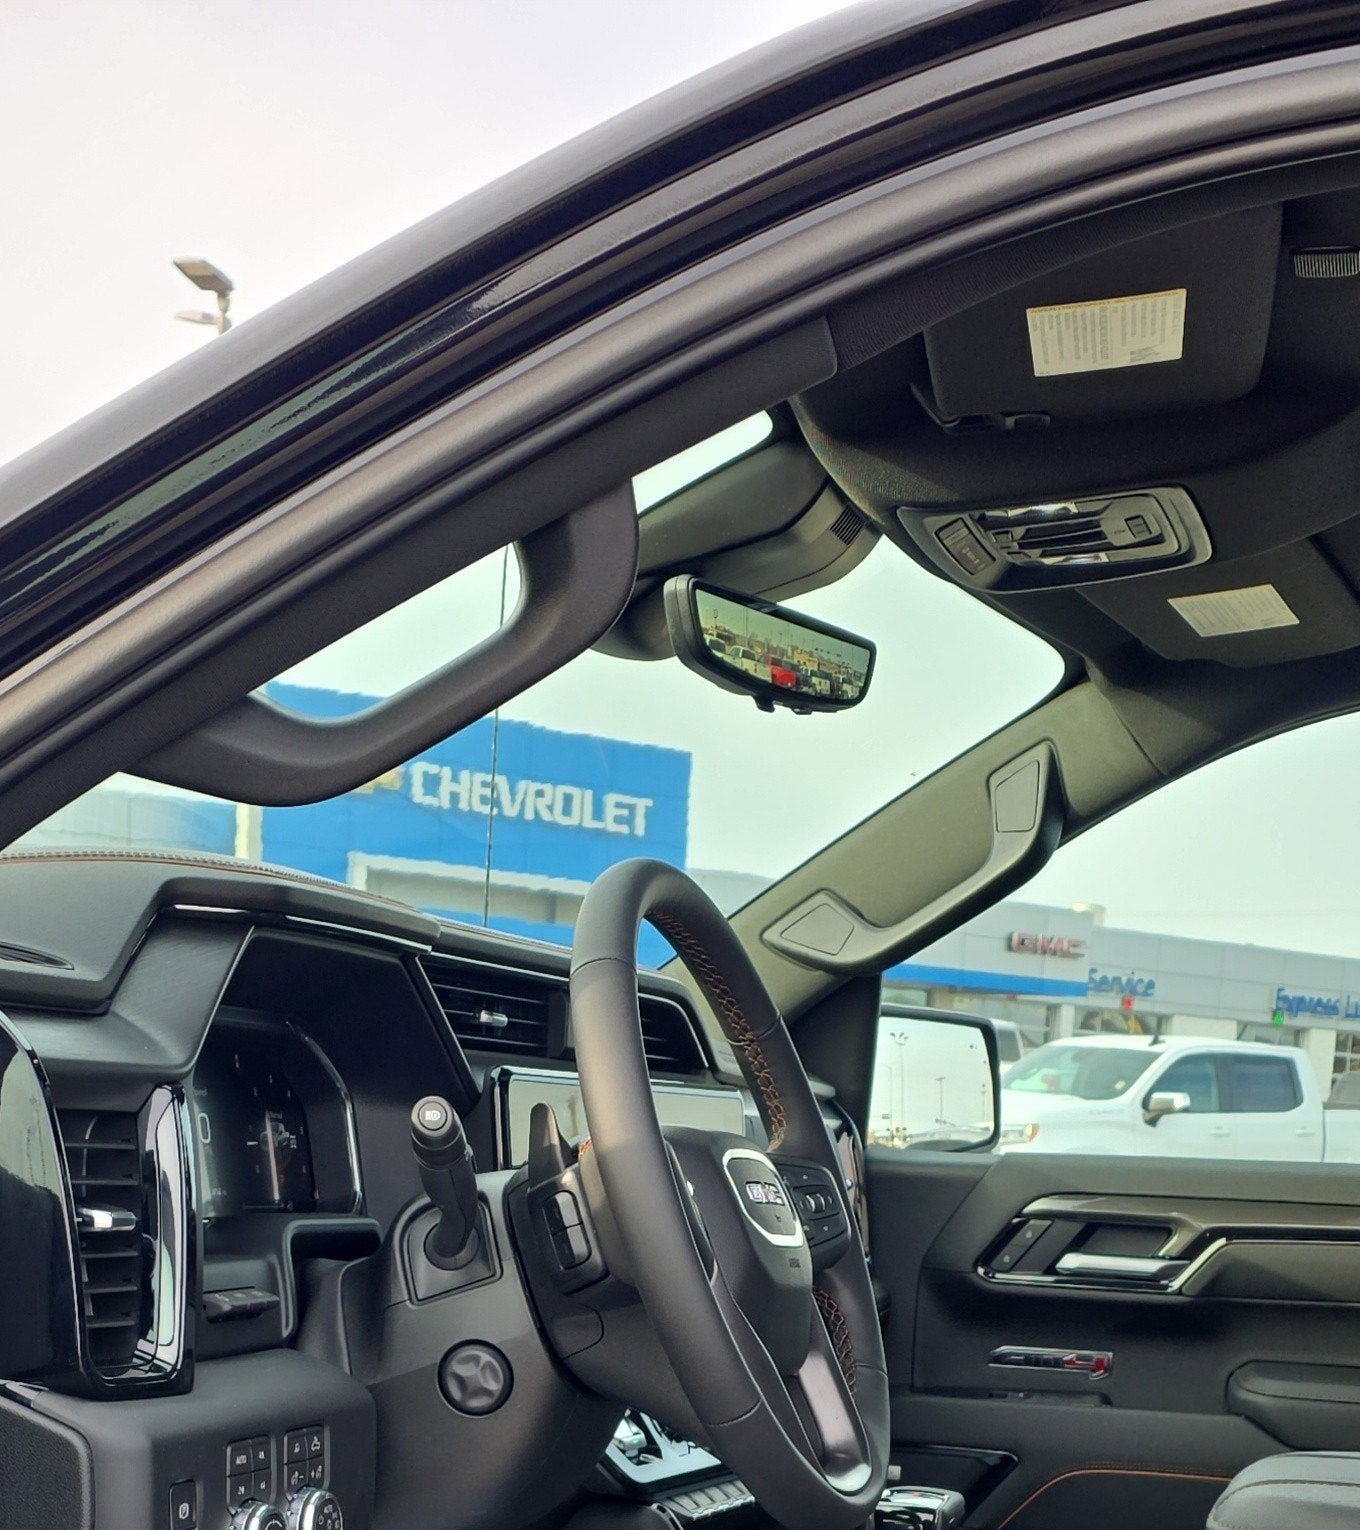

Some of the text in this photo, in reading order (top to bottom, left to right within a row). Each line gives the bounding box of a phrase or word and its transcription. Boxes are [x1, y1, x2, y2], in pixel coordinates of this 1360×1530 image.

[410, 760, 653, 838] CHEVROLET
[1006, 931, 1086, 958] GMC
[1087, 966, 1157, 997] Service
[1275, 986, 1340, 1018] Express
[745, 1182, 786, 1206] GMC
